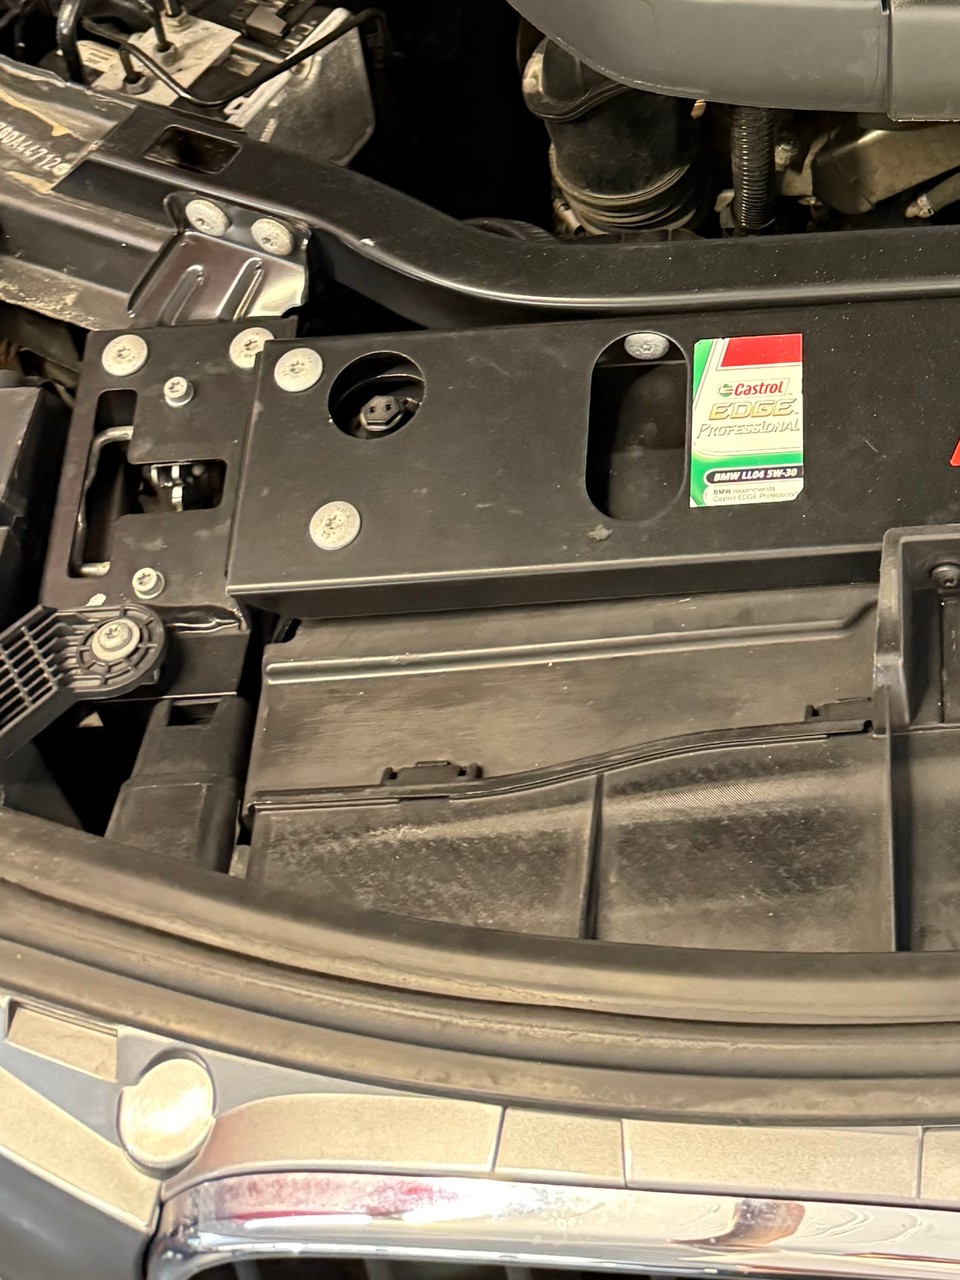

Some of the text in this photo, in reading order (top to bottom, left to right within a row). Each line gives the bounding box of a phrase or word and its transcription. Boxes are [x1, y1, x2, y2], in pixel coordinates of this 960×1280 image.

[734, 381, 784, 396] Castrol
[708, 398, 797, 420] EDGE
[713, 468, 798, 482] BMW LL04 5W-30
